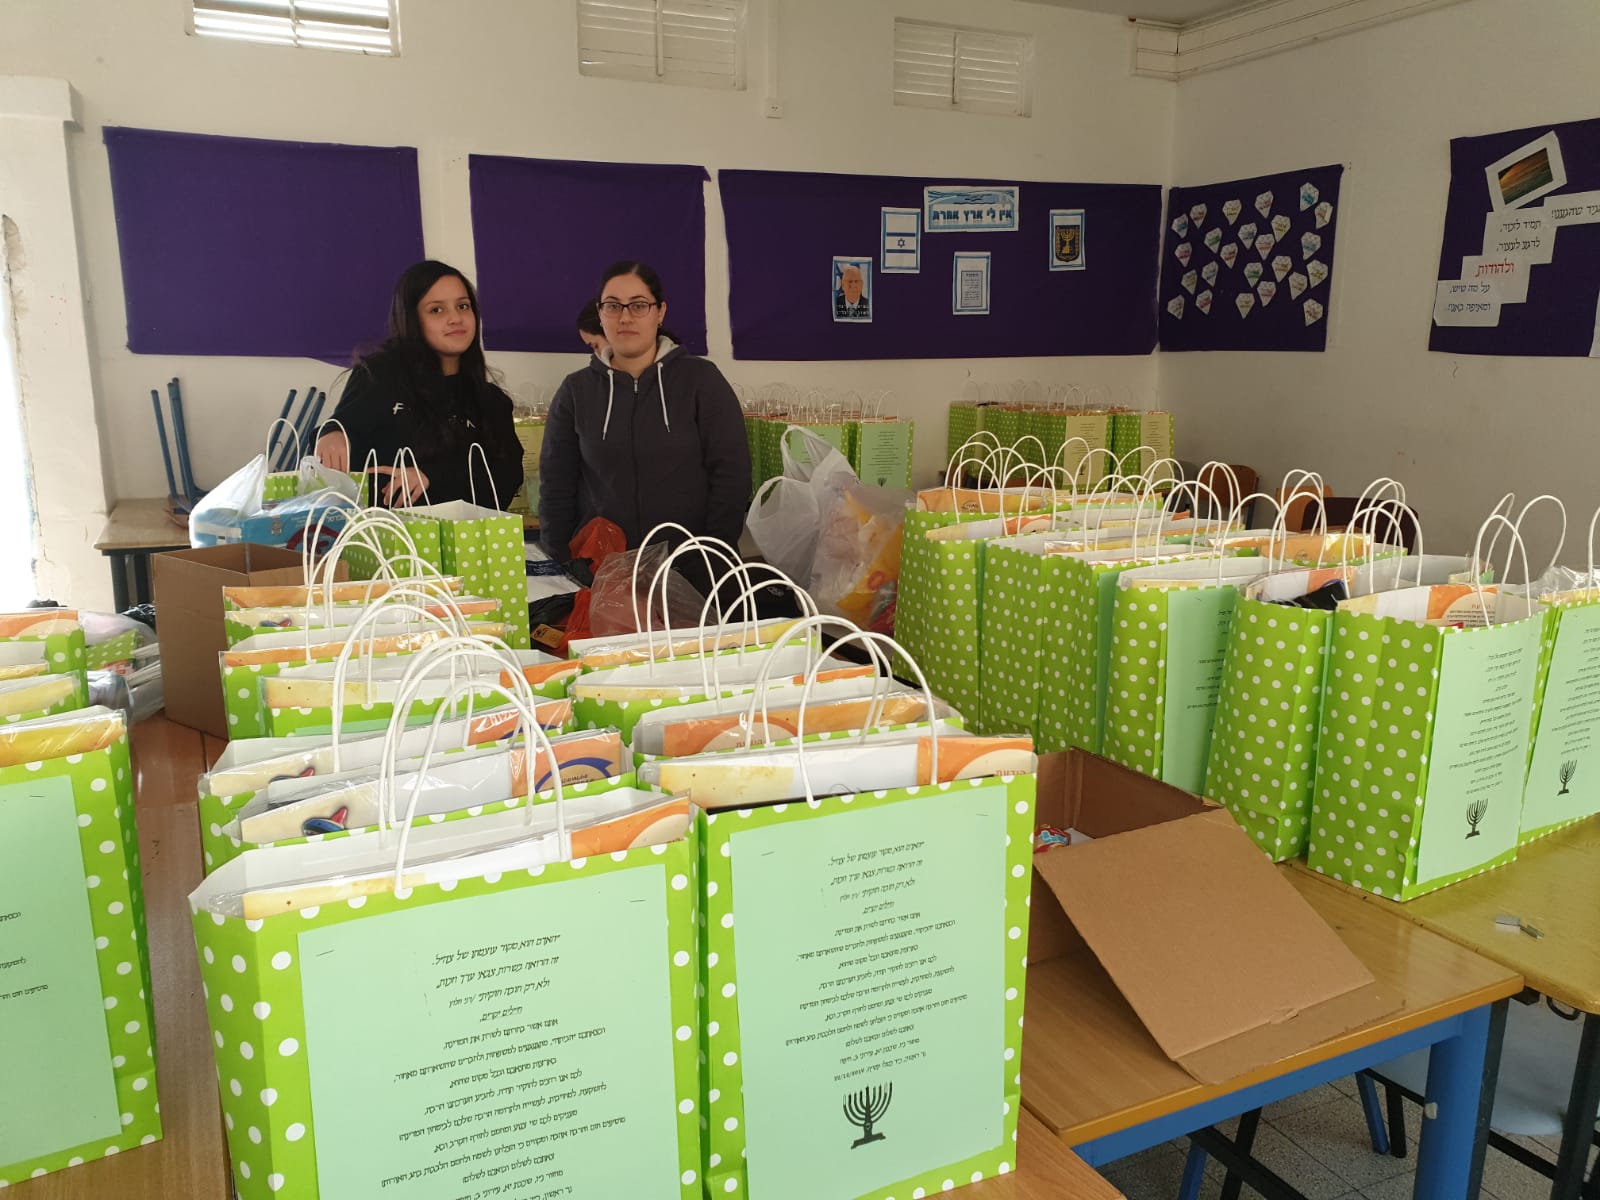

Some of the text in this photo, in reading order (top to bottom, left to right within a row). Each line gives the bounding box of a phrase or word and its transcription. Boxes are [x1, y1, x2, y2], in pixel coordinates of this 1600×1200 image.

[932, 207, 1012, 222] אין לי ארץ אחרת
[1522, 220, 1542, 230] תמיד
[1521, 236, 1541, 250] לרגע
[1475, 257, 1515, 278] ולהודות
[1467, 284, 1479, 293] מה
[1480, 281, 1491, 295] על
[456, 950, 469, 960] של
[469, 1034, 480, 1044] את
[570, 1068, 582, 1079] לכם
[539, 1113, 551, 1124] לכם
